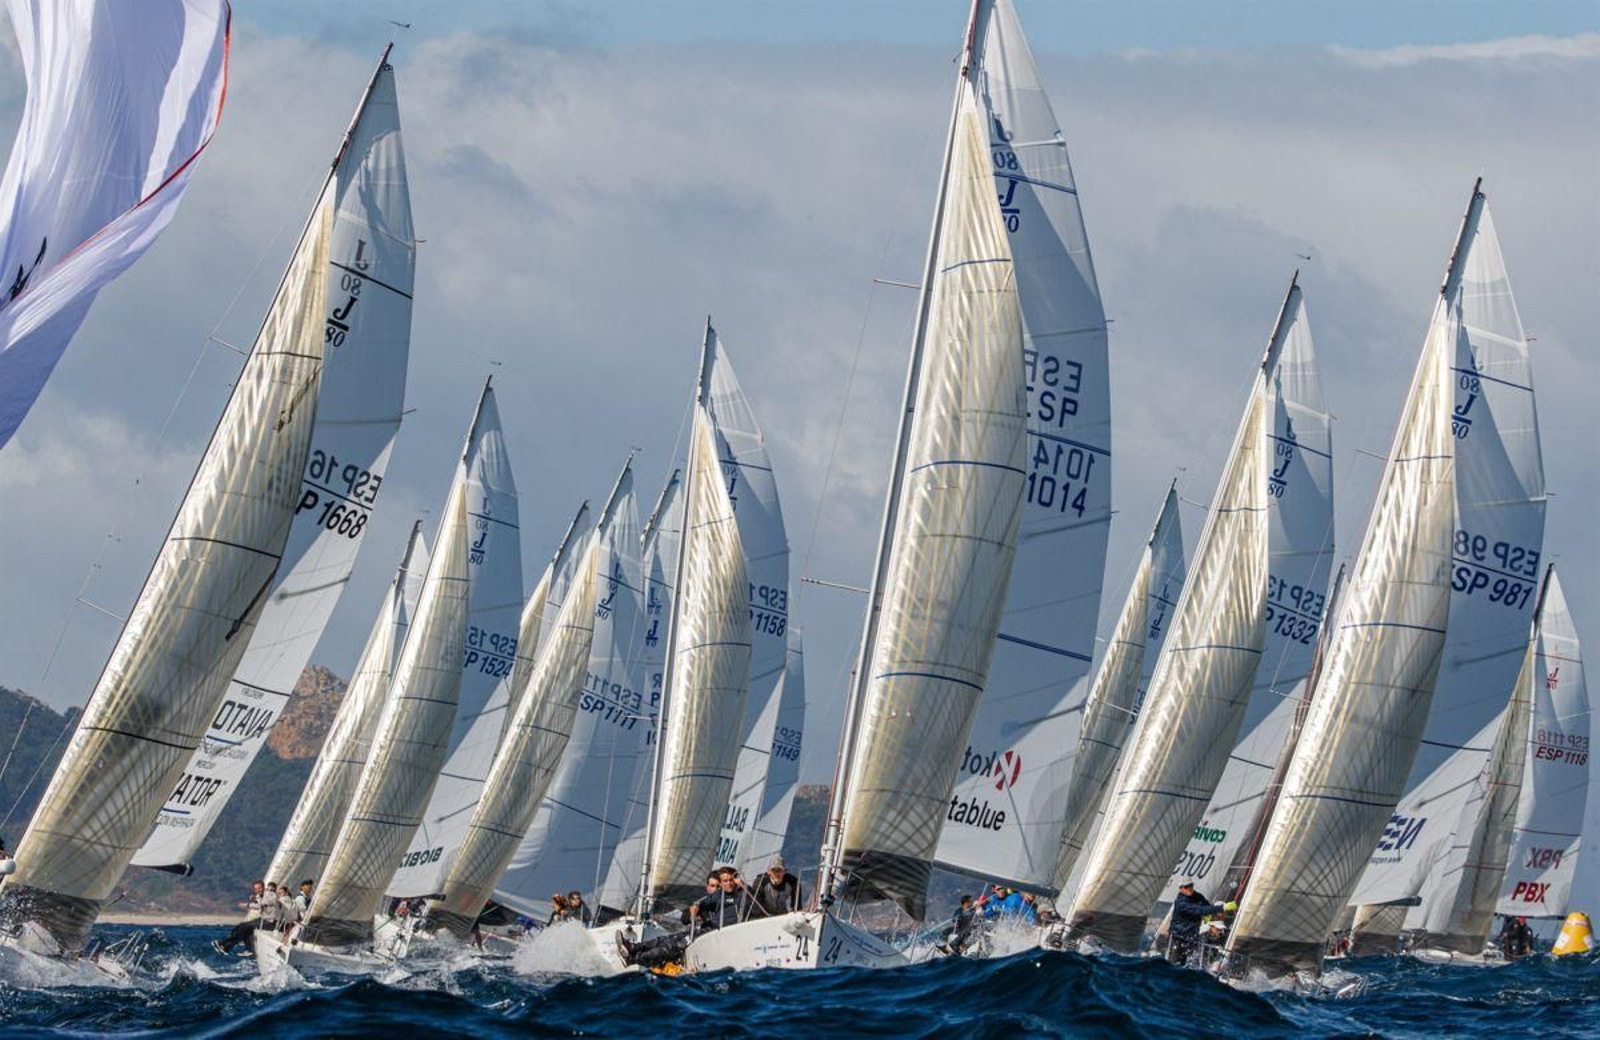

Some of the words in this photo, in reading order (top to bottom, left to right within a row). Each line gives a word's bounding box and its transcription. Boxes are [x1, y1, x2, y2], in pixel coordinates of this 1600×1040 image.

[999, 180, 1017, 206] J
[1001, 214, 1019, 233] 0
[333, 297, 358, 321] J
[1025, 386, 1078, 429] SP
[1455, 394, 1477, 416] J
[1272, 459, 1291, 478] J
[1027, 472, 1087, 519] 1014
[317, 501, 368, 539] 1668
[1452, 565, 1489, 596] SP
[1489, 578, 1533, 611] 981
[756, 612, 786, 637] 1158
[1274, 612, 1317, 645] 1332
[464, 650, 478, 669] P
[480, 655, 513, 680] 1524
[580, 692, 605, 714] SP
[775, 744, 800, 761] 1149
[1535, 746, 1564, 763] ESP
[1564, 750, 1588, 766] 1118
[168, 772, 222, 807] ATOR
[947, 795, 1006, 831] tablue
[1511, 881, 1551, 904] PBX
[796, 934, 809, 962] 24
[824, 936, 843, 964] 24
